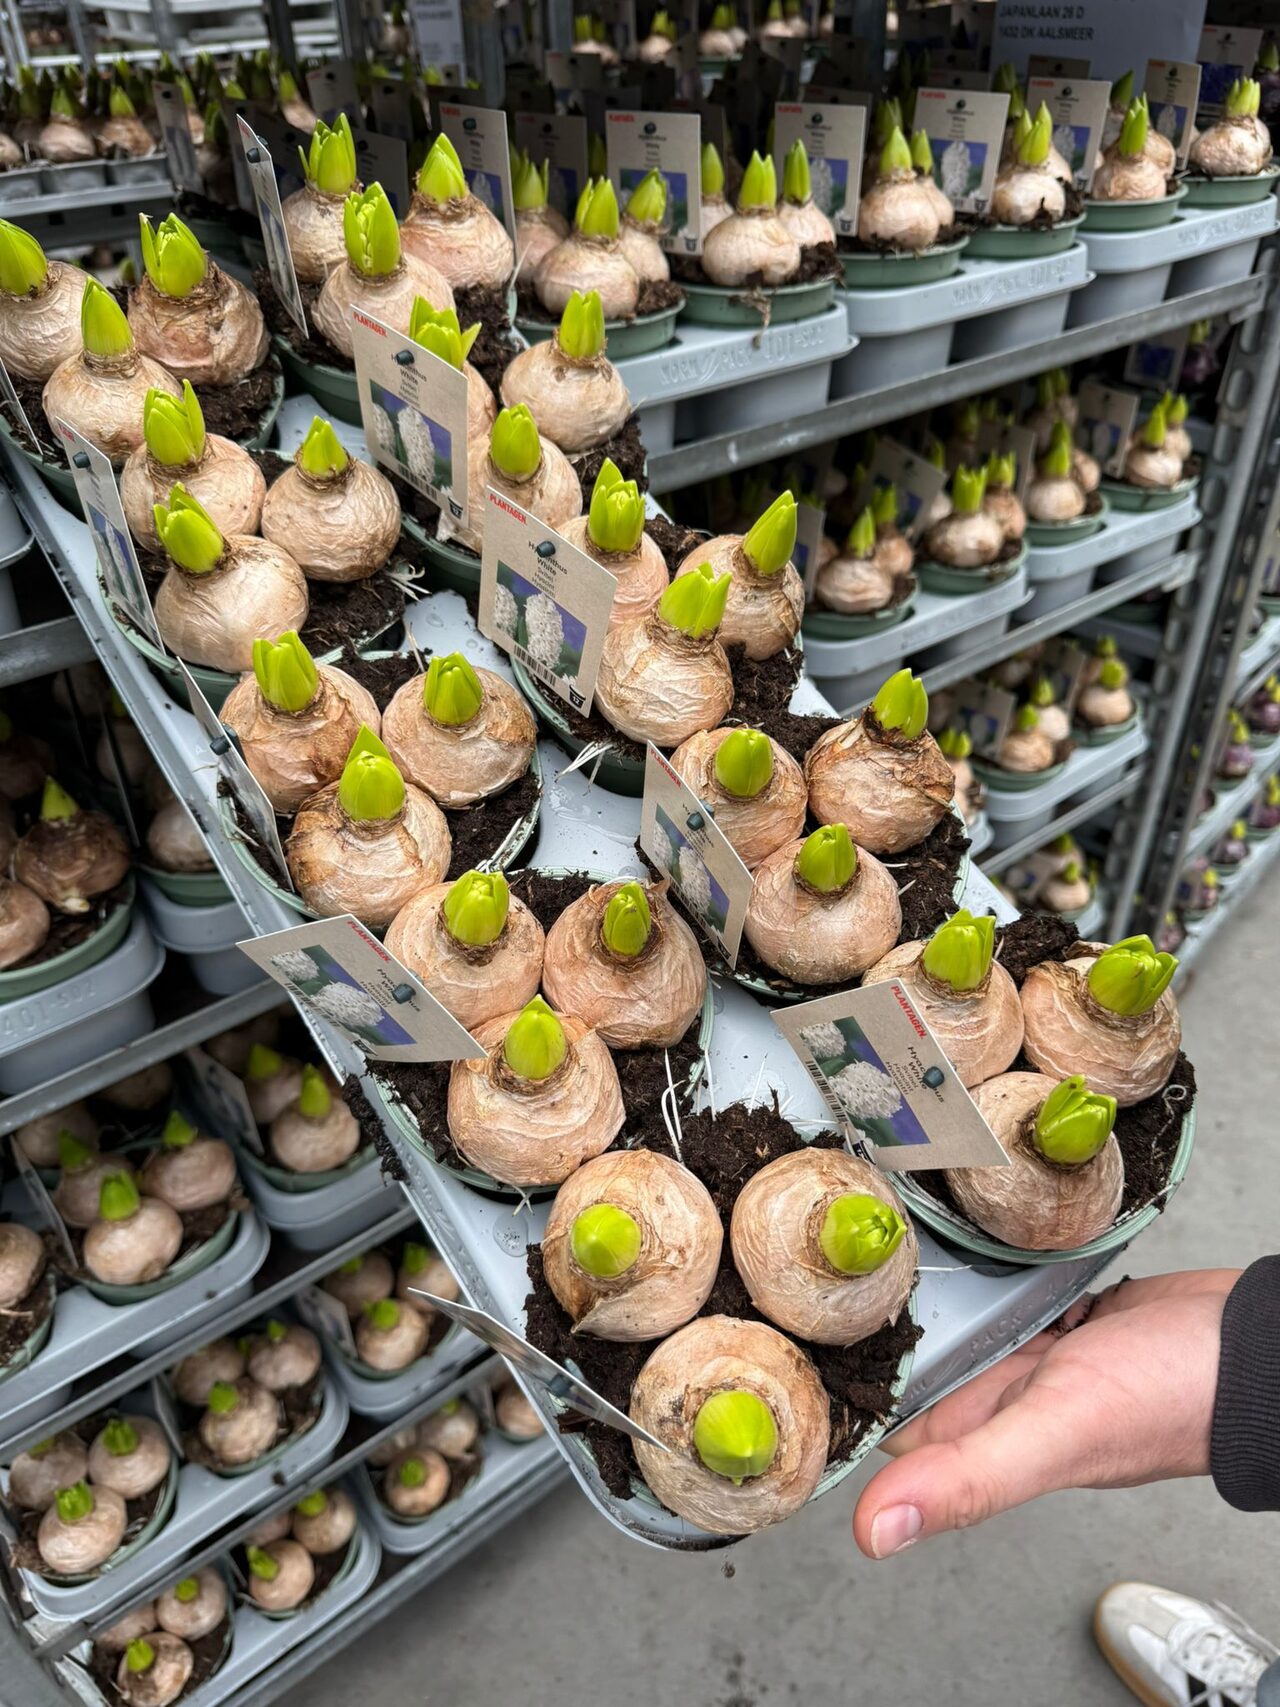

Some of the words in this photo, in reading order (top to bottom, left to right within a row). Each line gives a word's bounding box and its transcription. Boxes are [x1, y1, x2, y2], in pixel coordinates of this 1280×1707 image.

[400, 369, 418, 385] White
[537, 557, 557, 576] White
[893, 1063, 914, 1093] Hyacint
[908, 1061, 928, 1090] White
